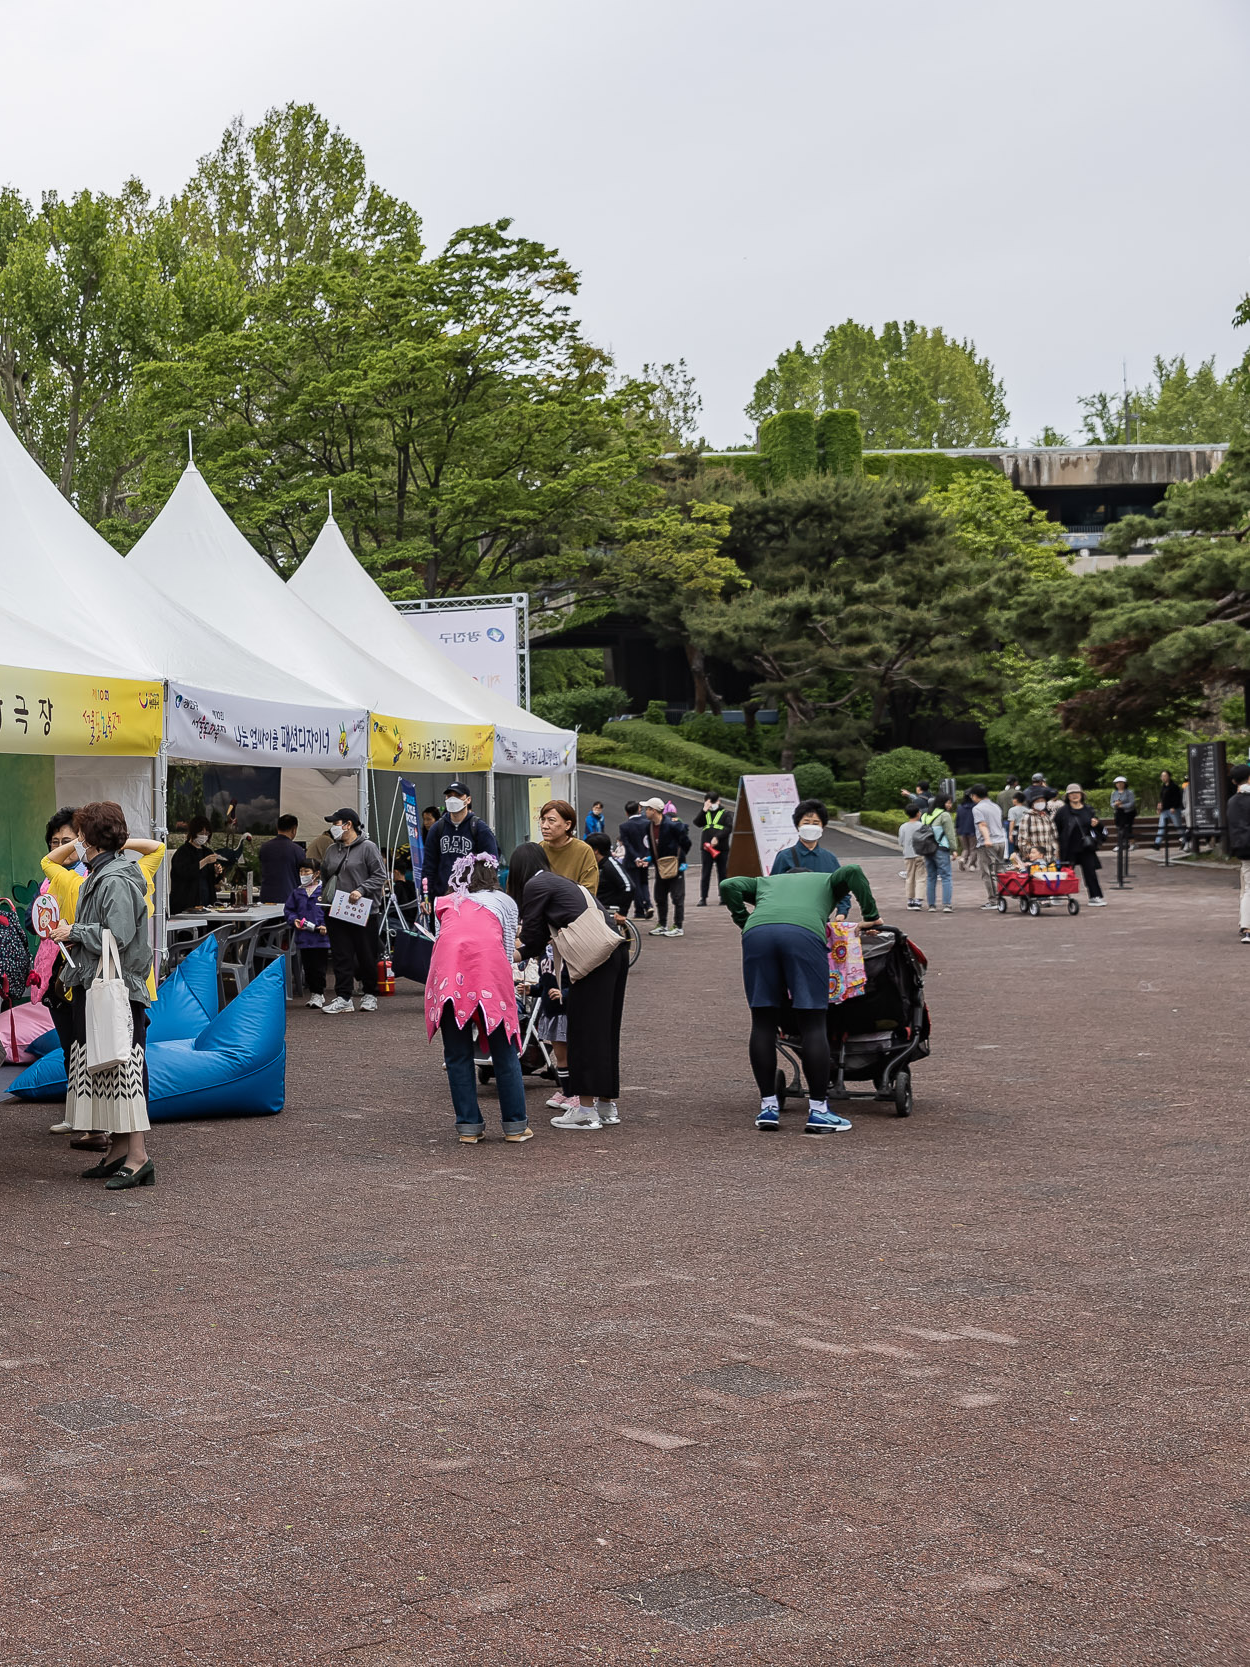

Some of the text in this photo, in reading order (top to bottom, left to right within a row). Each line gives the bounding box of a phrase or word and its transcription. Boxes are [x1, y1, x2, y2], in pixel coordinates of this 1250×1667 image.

[91, 688, 110, 702] 제10회
[234, 725, 250, 748] 나는
[440, 835, 473, 856] GAP
